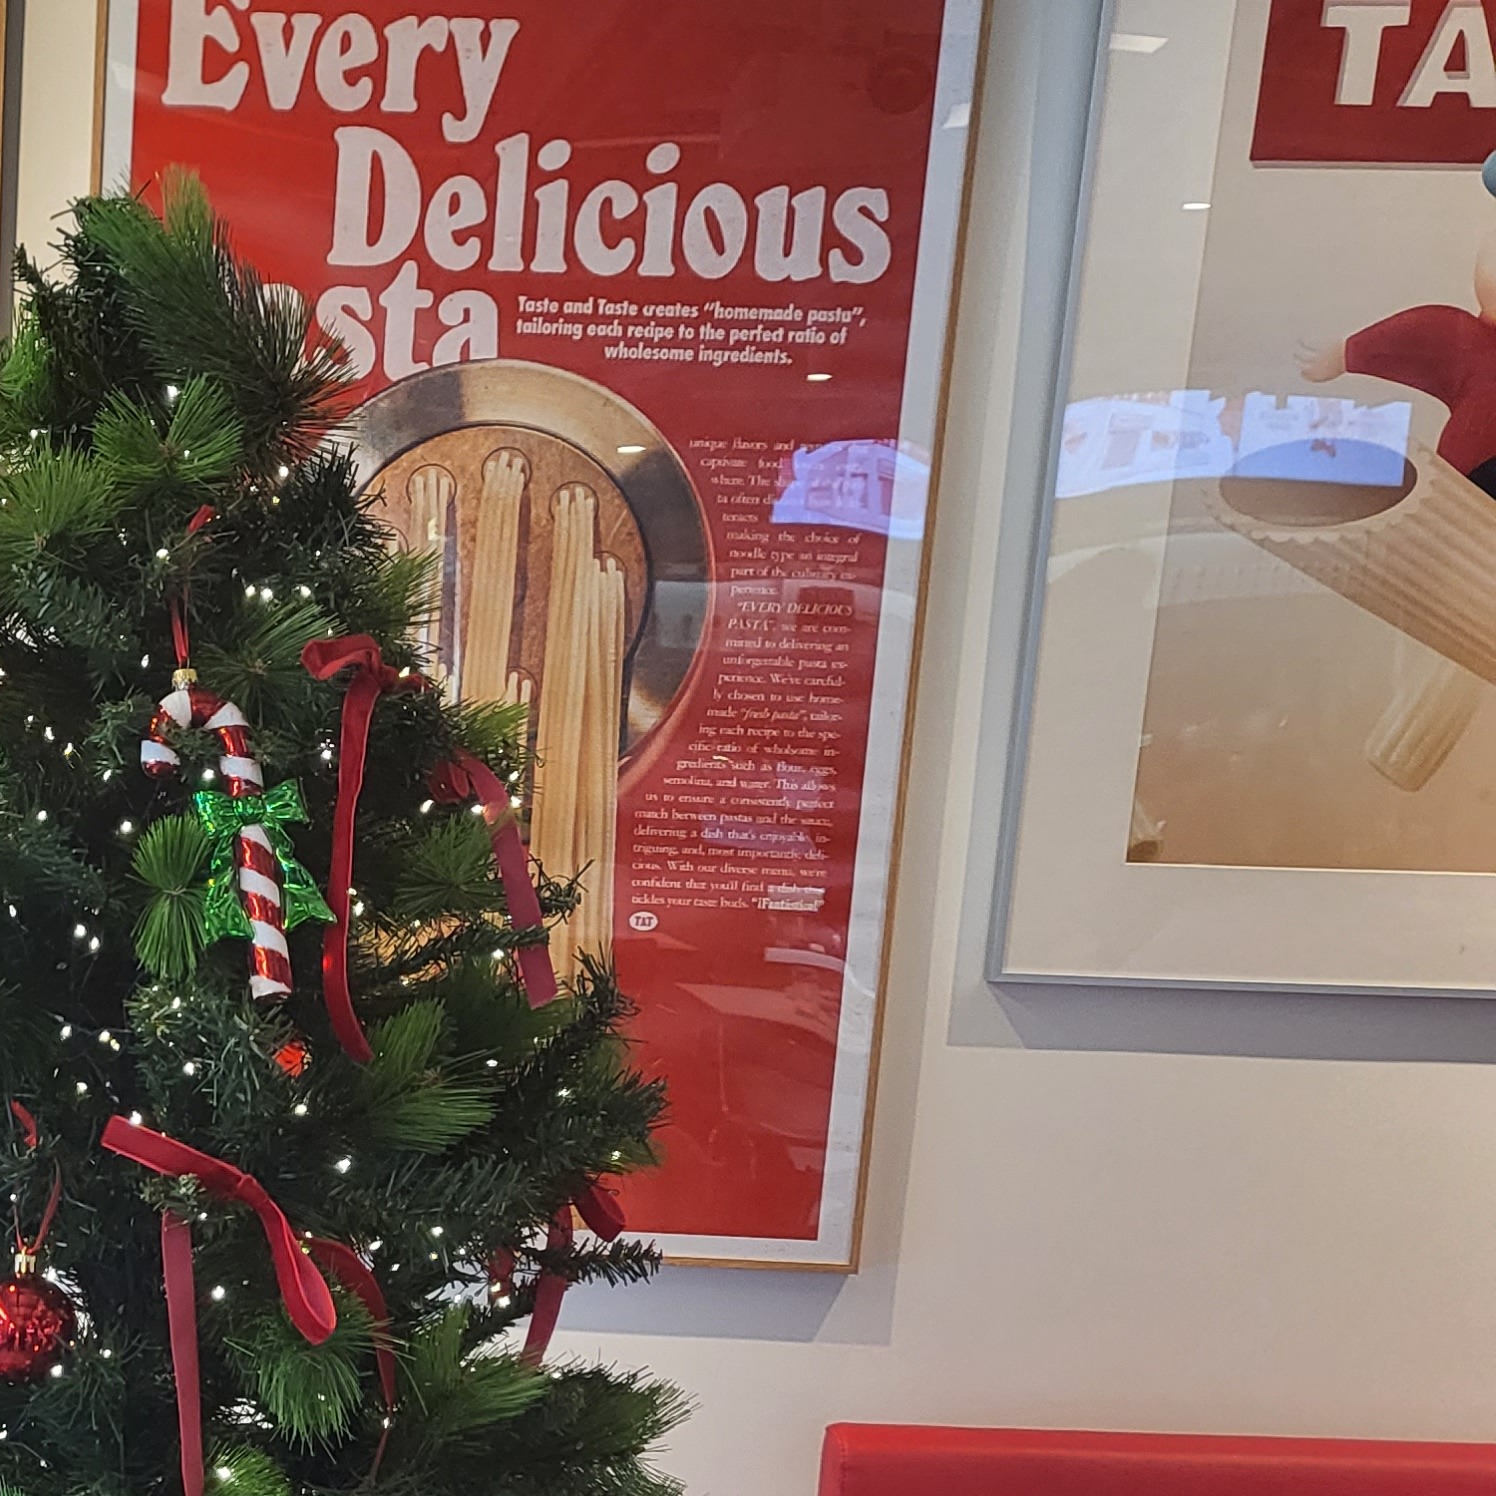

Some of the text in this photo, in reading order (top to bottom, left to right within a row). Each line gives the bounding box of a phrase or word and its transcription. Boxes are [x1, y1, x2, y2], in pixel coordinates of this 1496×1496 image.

[161, 0, 521, 143] Every
[326, 126, 893, 284] Delicious
[517, 295, 559, 314] Taste
[564, 297, 593, 315] and
[598, 298, 638, 317] Taste
[642, 303, 699, 319] creates
[516, 317, 849, 346] tailoring each recipe to the perfect ratio of
[604, 341, 793, 366] wholesome ingredients.
[778, 530, 794, 542] the
[848, 533, 860, 545] of
[729, 546, 766, 558] noodle
[771, 549, 795, 562] type
[730, 565, 753, 579] part
[756, 565, 769, 576] of
[765, 638, 776, 648] to
[779, 637, 832, 653] delivering
[798, 657, 827, 671] pasta
[727, 689, 764, 701] chosen
[770, 692, 782, 702] to
[719, 723, 744, 735] each
[783, 727, 794, 737] to
[797, 727, 814, 738] the
[715, 775, 736, 787] and
[663, 792, 675, 802] to
[671, 809, 717, 822] between
[756, 813, 777, 824] and
[780, 814, 797, 825] the
[700, 827, 723, 839] dish
[666, 860, 694, 872] With
[697, 864, 717, 873] our
[667, 897, 691, 909] your
